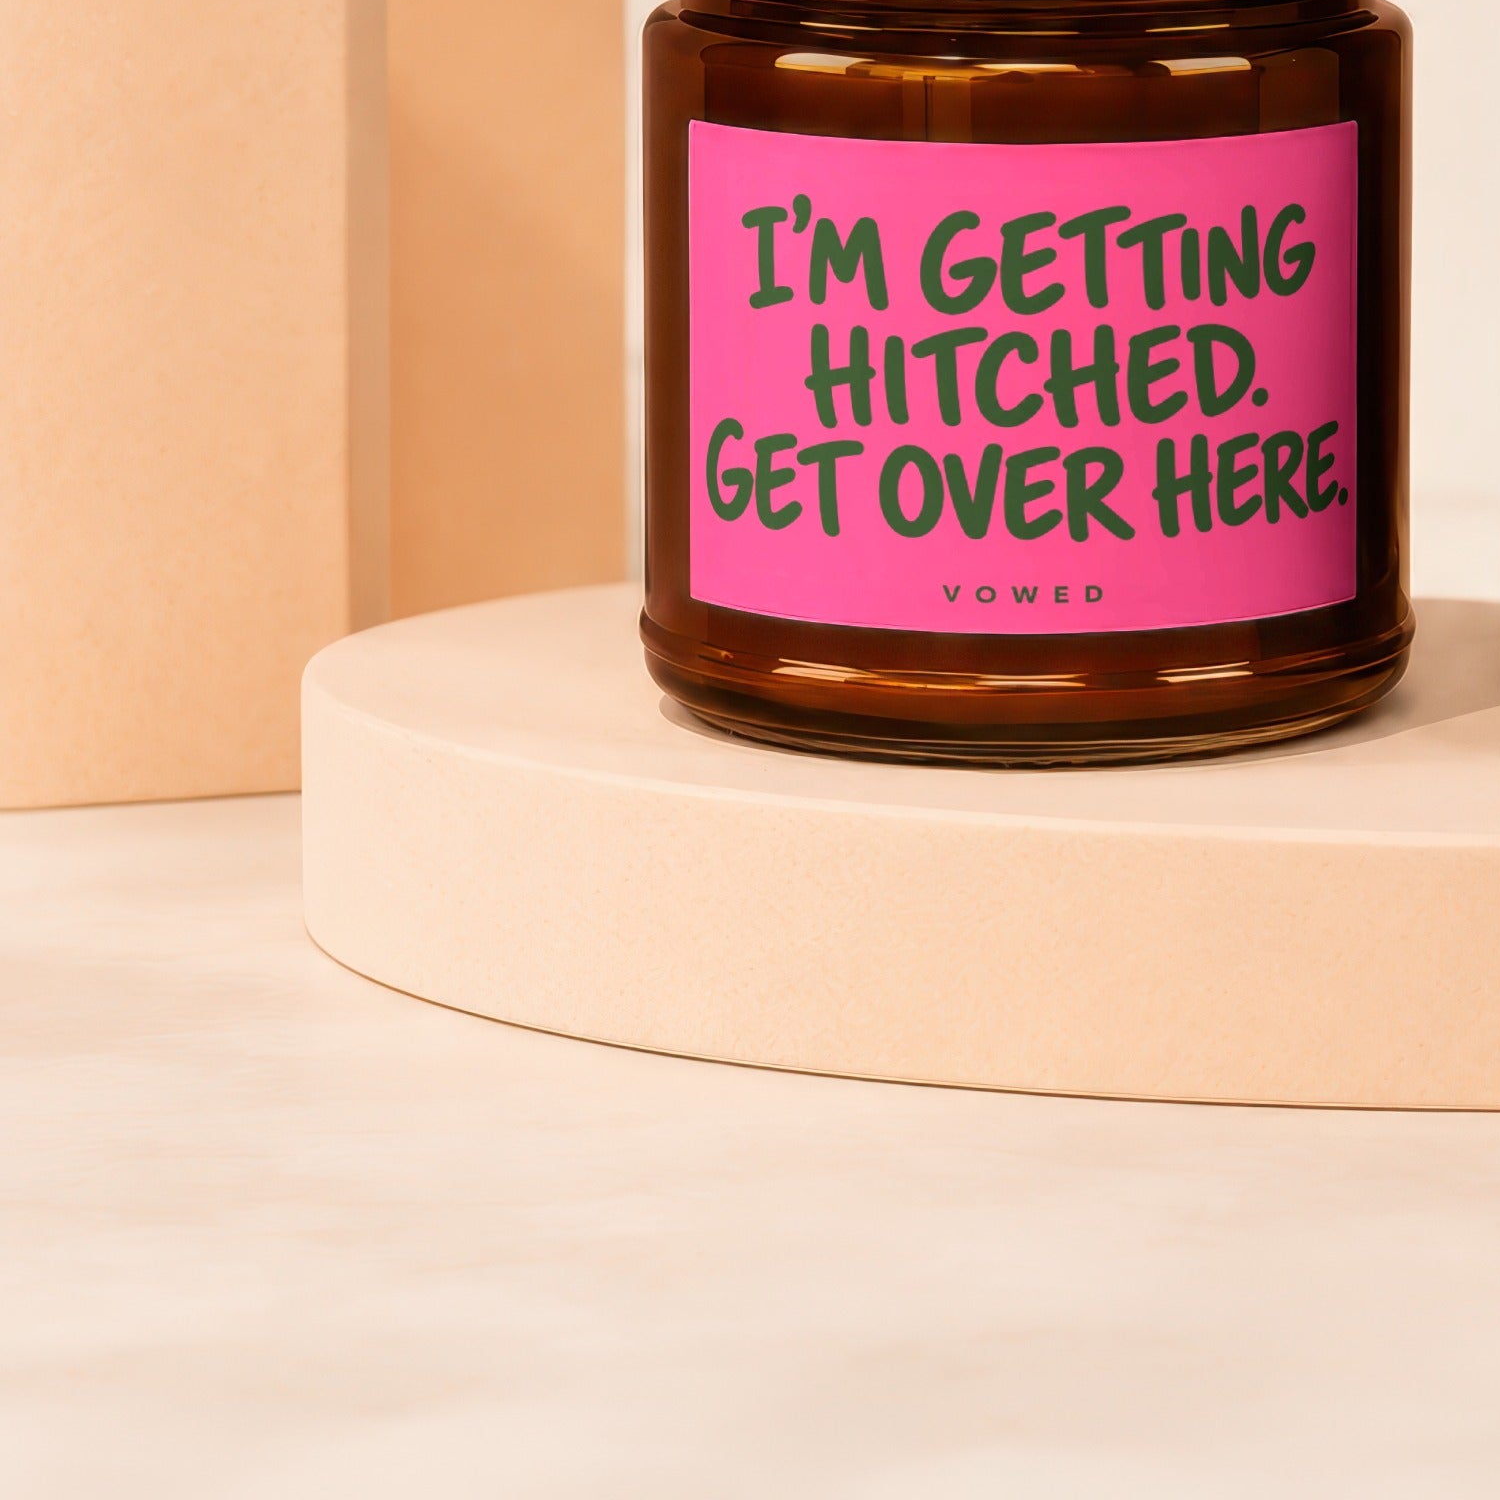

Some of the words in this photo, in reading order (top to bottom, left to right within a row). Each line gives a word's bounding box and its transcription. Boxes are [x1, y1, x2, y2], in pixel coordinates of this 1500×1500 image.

[741, 193, 889, 311] I'M
[919, 203, 1316, 315] GETTING
[804, 323, 1269, 429] HITCHED.
[705, 417, 866, 537] GET
[878, 443, 1135, 543] OVER
[1151, 419, 1349, 538] HERE.
[943, 585, 1103, 603] VOWED
